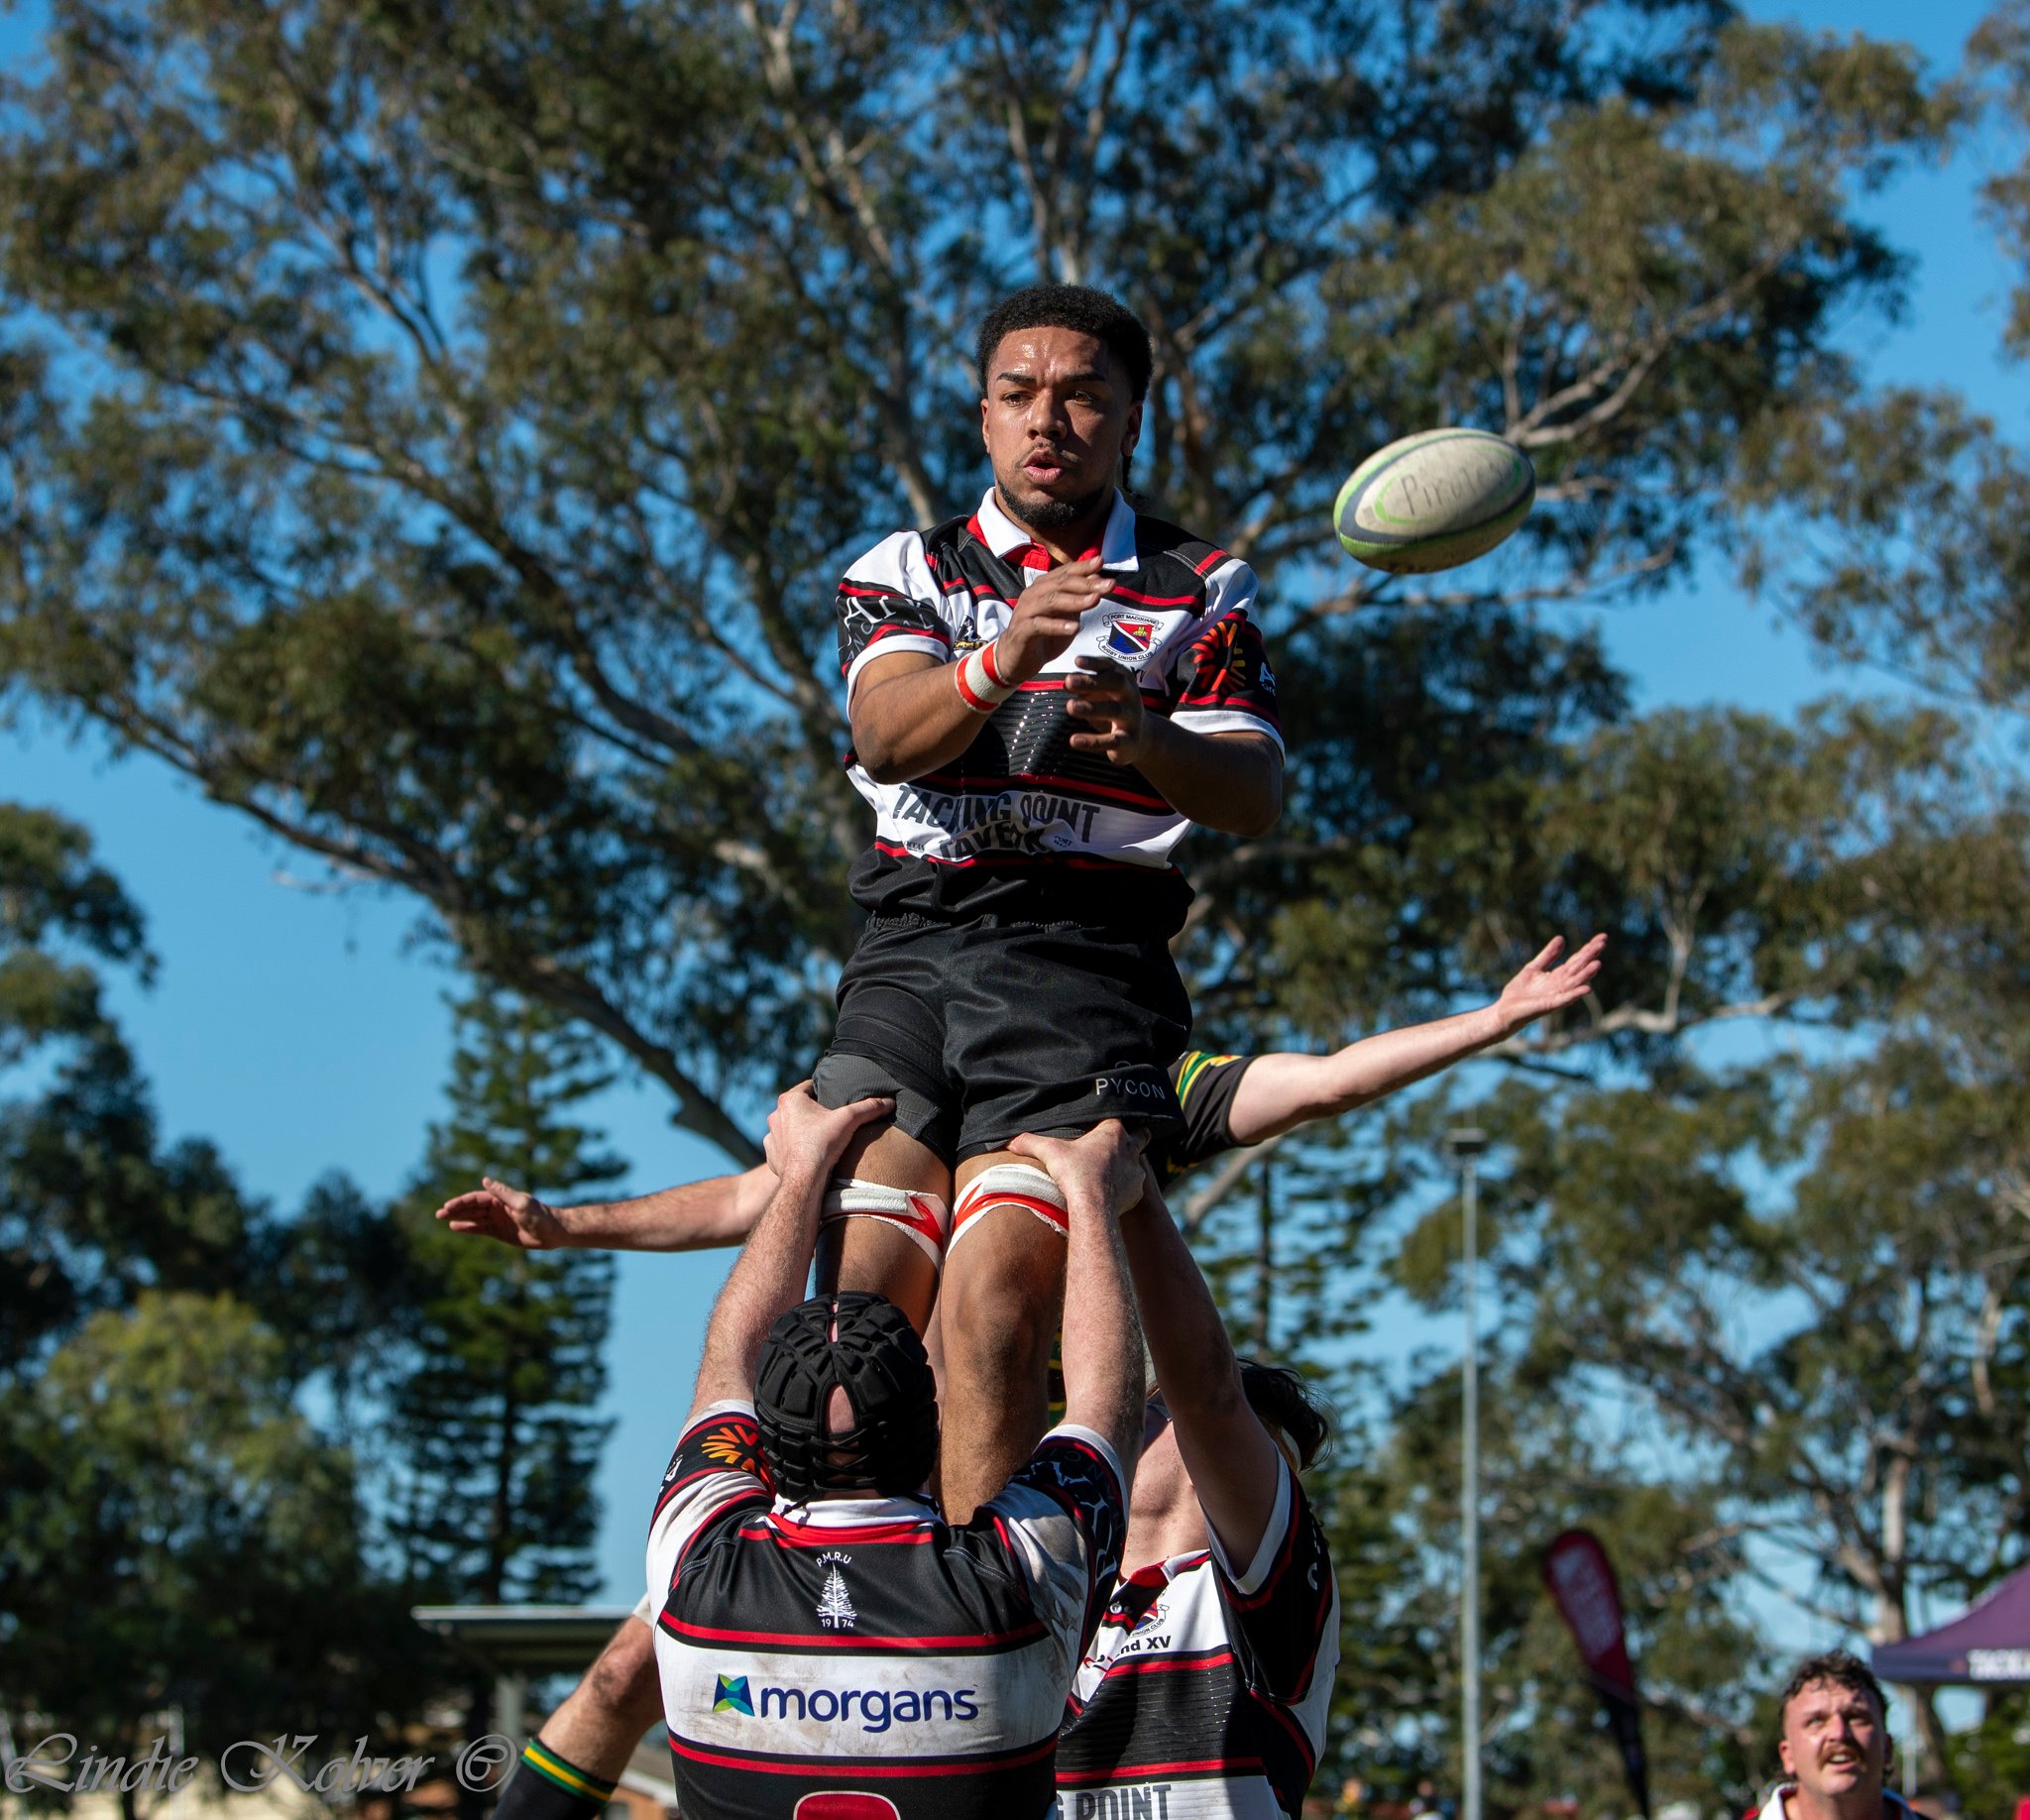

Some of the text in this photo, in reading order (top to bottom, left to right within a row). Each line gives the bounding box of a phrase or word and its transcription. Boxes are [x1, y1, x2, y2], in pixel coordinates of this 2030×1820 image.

[1138, 651, 1154, 660] CLUB
[1095, 1078, 1166, 1100] PYCON
[822, 1618, 854, 1628] 19 74
[1115, 1635, 1172, 1657] nd XV
[760, 1687, 979, 1734] morgans
[1075, 1783, 1172, 1820] POINT
